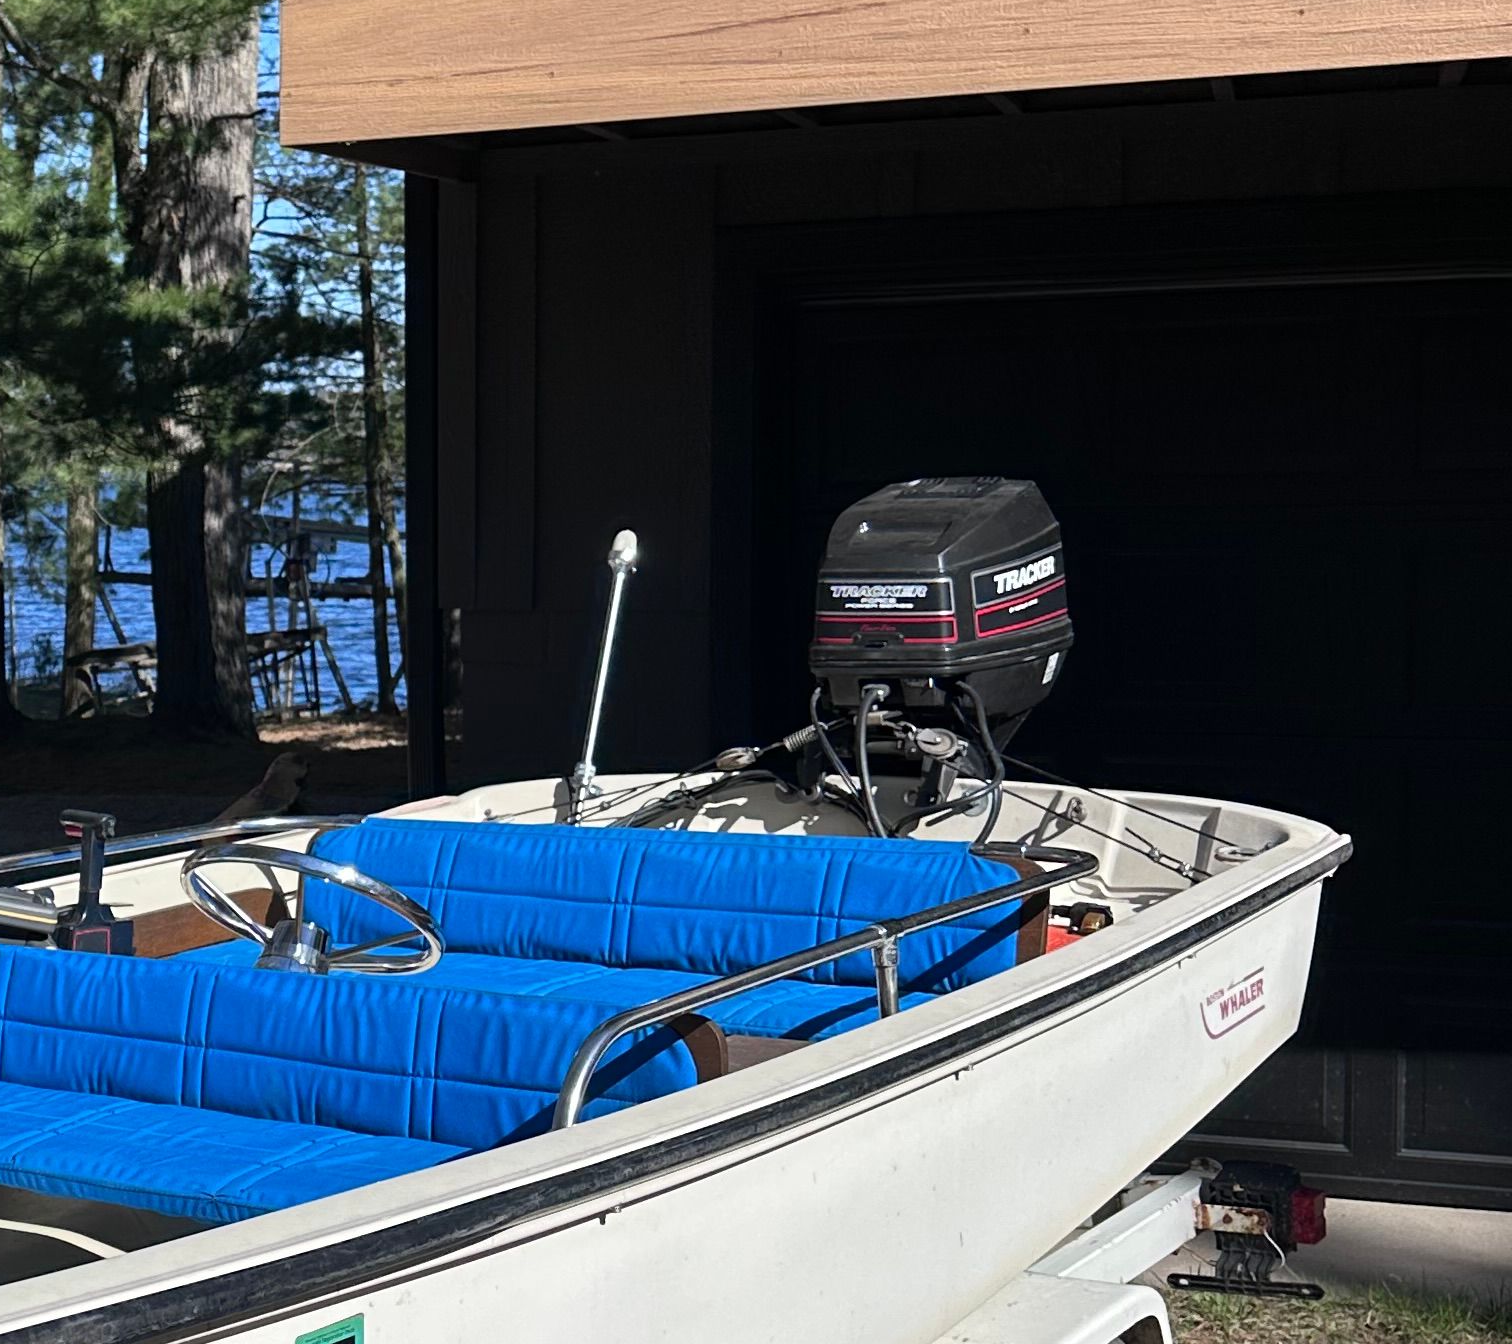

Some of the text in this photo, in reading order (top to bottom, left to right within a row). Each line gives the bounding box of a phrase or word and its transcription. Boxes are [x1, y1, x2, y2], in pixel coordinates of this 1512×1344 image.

[830, 585, 928, 598] TRACKER
[993, 556, 1055, 594] TRACKER
[1219, 978, 1264, 1020] WHALER
